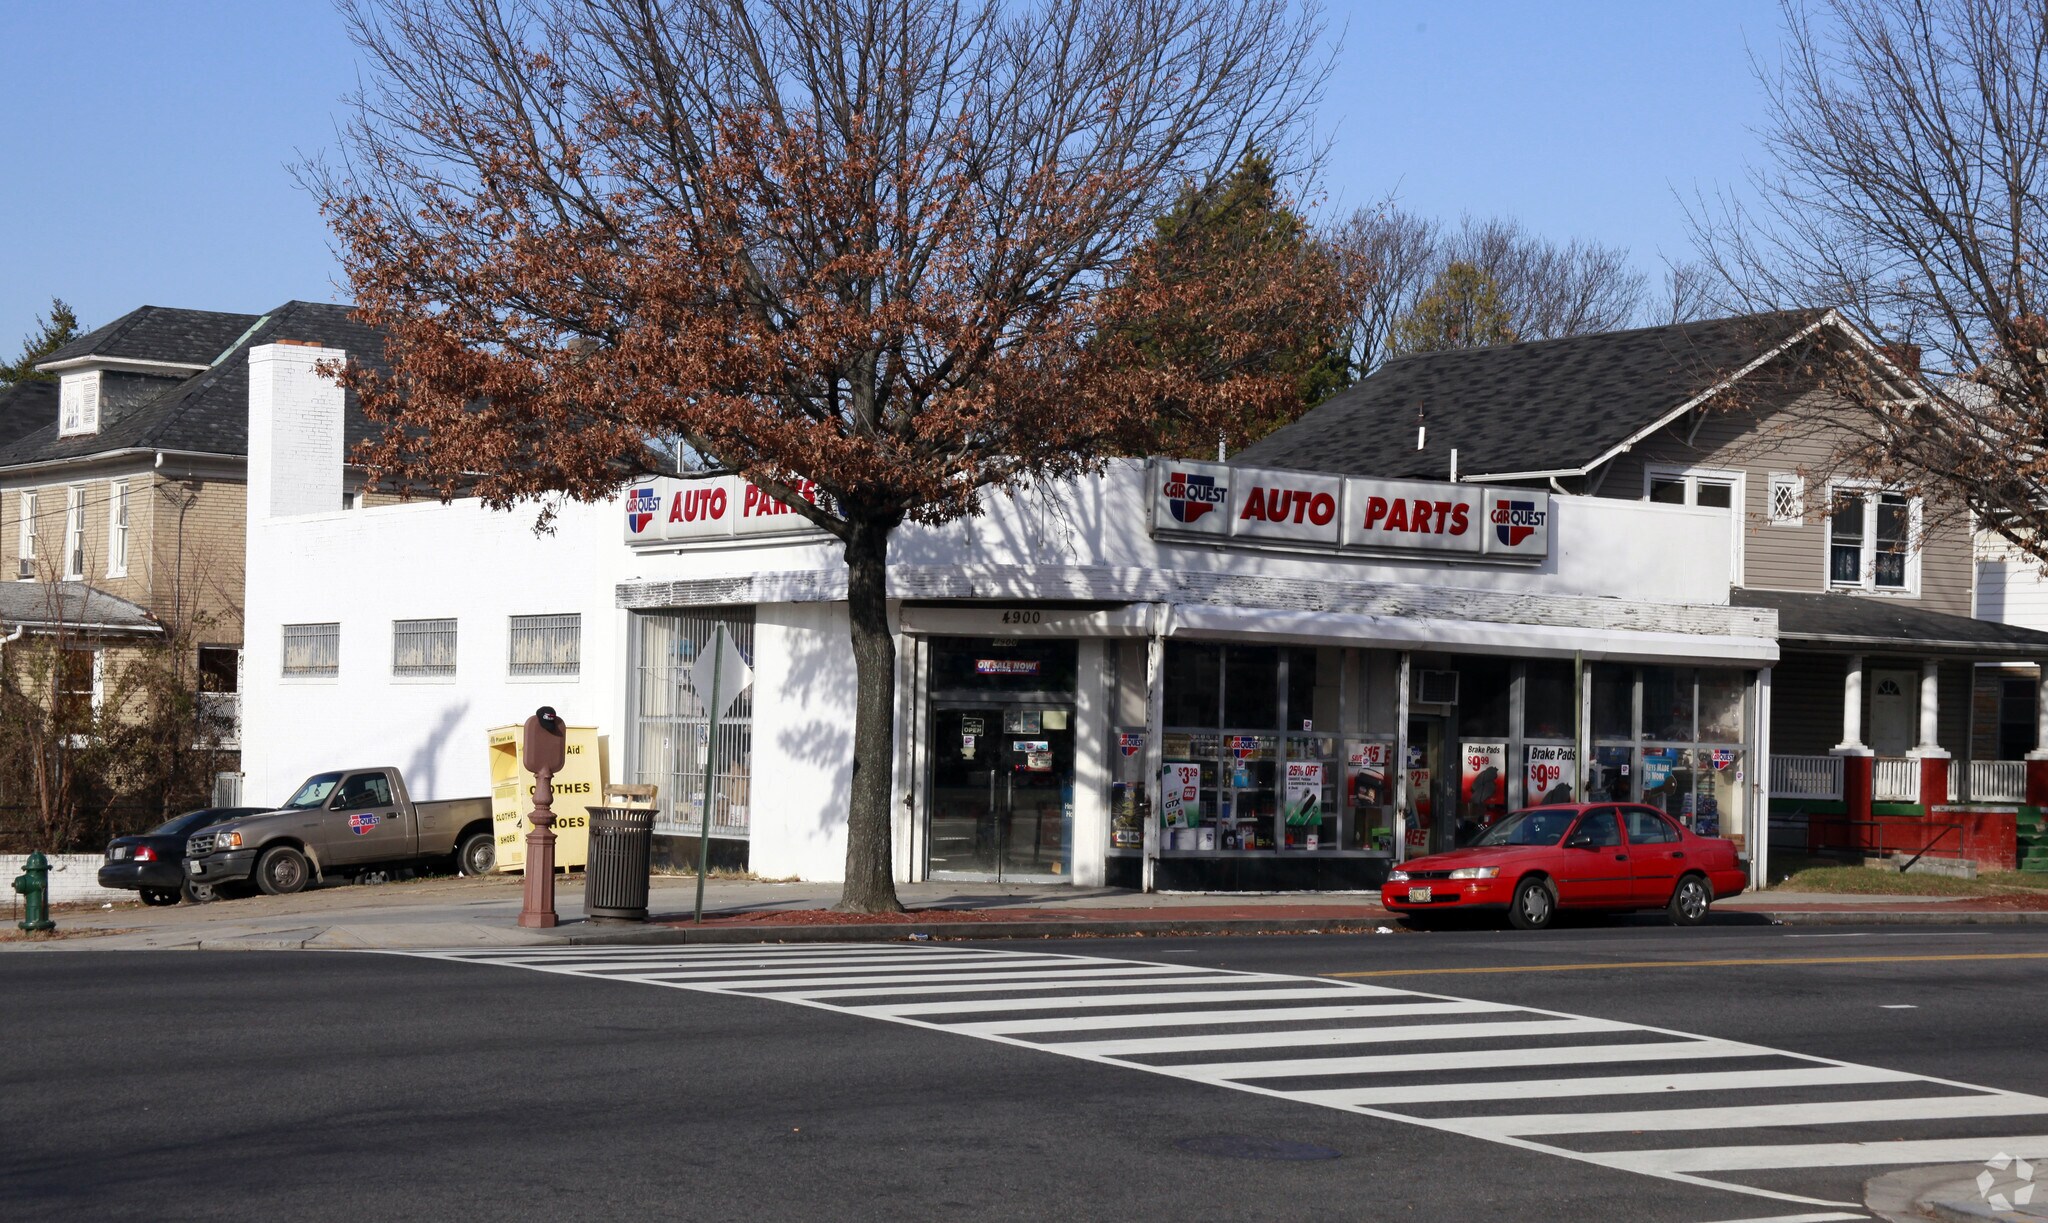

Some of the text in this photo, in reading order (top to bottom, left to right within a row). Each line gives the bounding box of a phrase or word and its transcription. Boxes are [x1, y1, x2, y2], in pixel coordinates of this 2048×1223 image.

[1163, 481, 1228, 503] CARQUEST
[626, 496, 662, 513] CARQUEST
[668, 479, 816, 523] AUTO PARS
[1240, 486, 1470, 536] AUTO PARTS
[1490, 509, 1546, 527] CARQUEST
[1002, 610, 1040, 624] 4900
[977, 661, 1037, 670] ON SALE NOW!
[566, 745, 580, 755] Aid
[1351, 754, 1363, 762] SAVE
[1363, 745, 1380, 762] $15
[1468, 746, 1500, 754] Brake Pads
[1531, 747, 1576, 761] Brake Pads
[1288, 765, 1319, 776] 25% OFF
[529, 782, 590, 796] COTHES
[1165, 798, 1180, 809] GTX
[496, 811, 517, 822] CLOTHES
[549, 817, 585, 829] HOES
[500, 834, 516, 844] SHOES
[1405, 829, 1427, 847] REE
